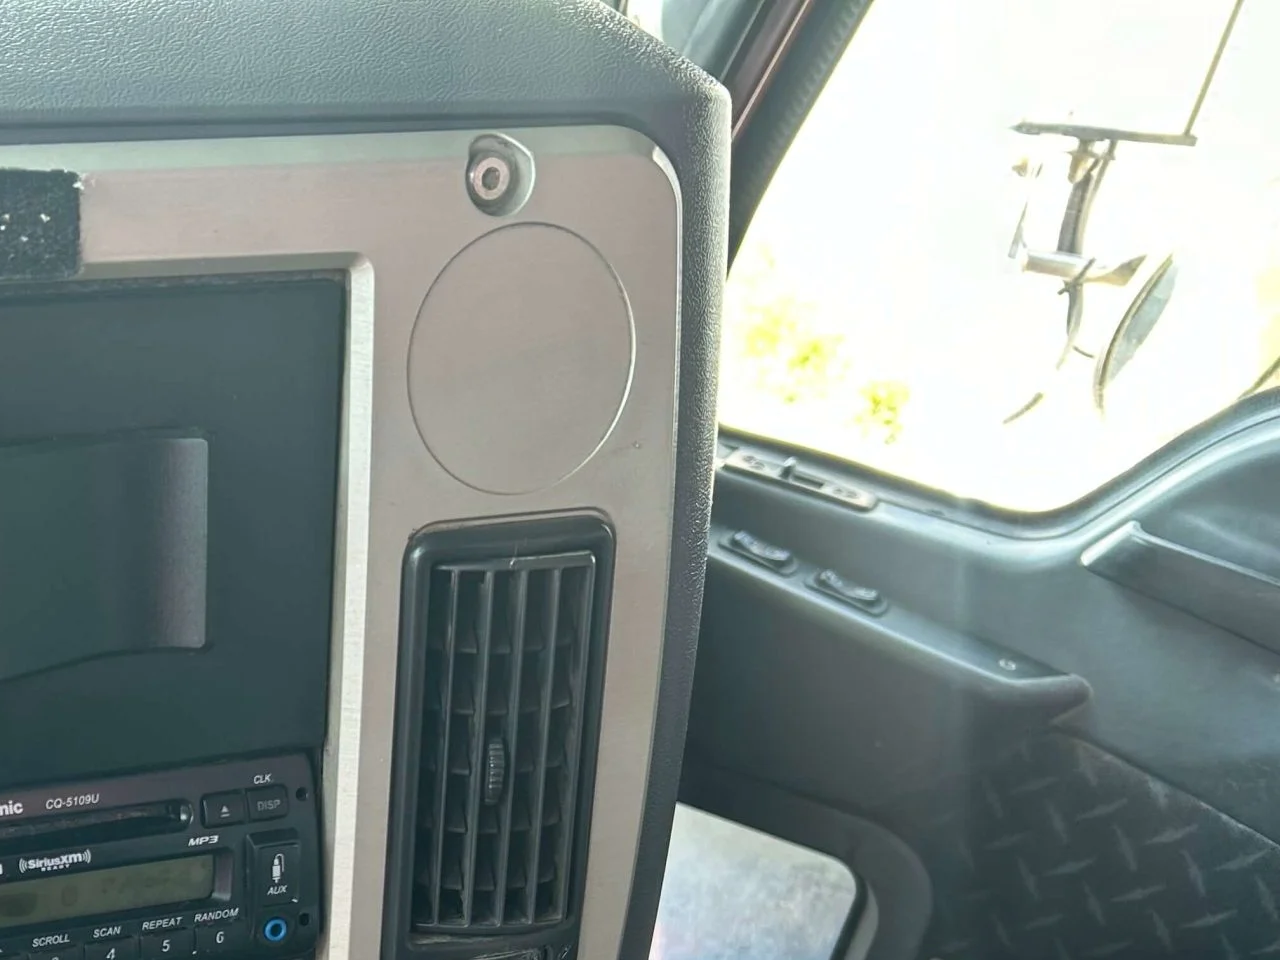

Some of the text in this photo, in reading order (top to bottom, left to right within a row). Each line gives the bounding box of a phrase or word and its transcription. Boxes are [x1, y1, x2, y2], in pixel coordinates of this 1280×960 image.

[253, 773, 272, 785] CLK
[45, 793, 101, 810] CQ-5109U
[257, 799, 281, 811] DISP
[188, 835, 220, 847] MP3
[267, 885, 288, 896] AUX
[194, 907, 239, 922] RANDOM
[142, 916, 183, 931] REPEAT
[91, 926, 122, 939] SCAN
[216, 931, 224, 944] 6
[32, 933, 70, 948] SCROLL
[162, 939, 170, 952] 5
[106, 948, 115, 960] 4
